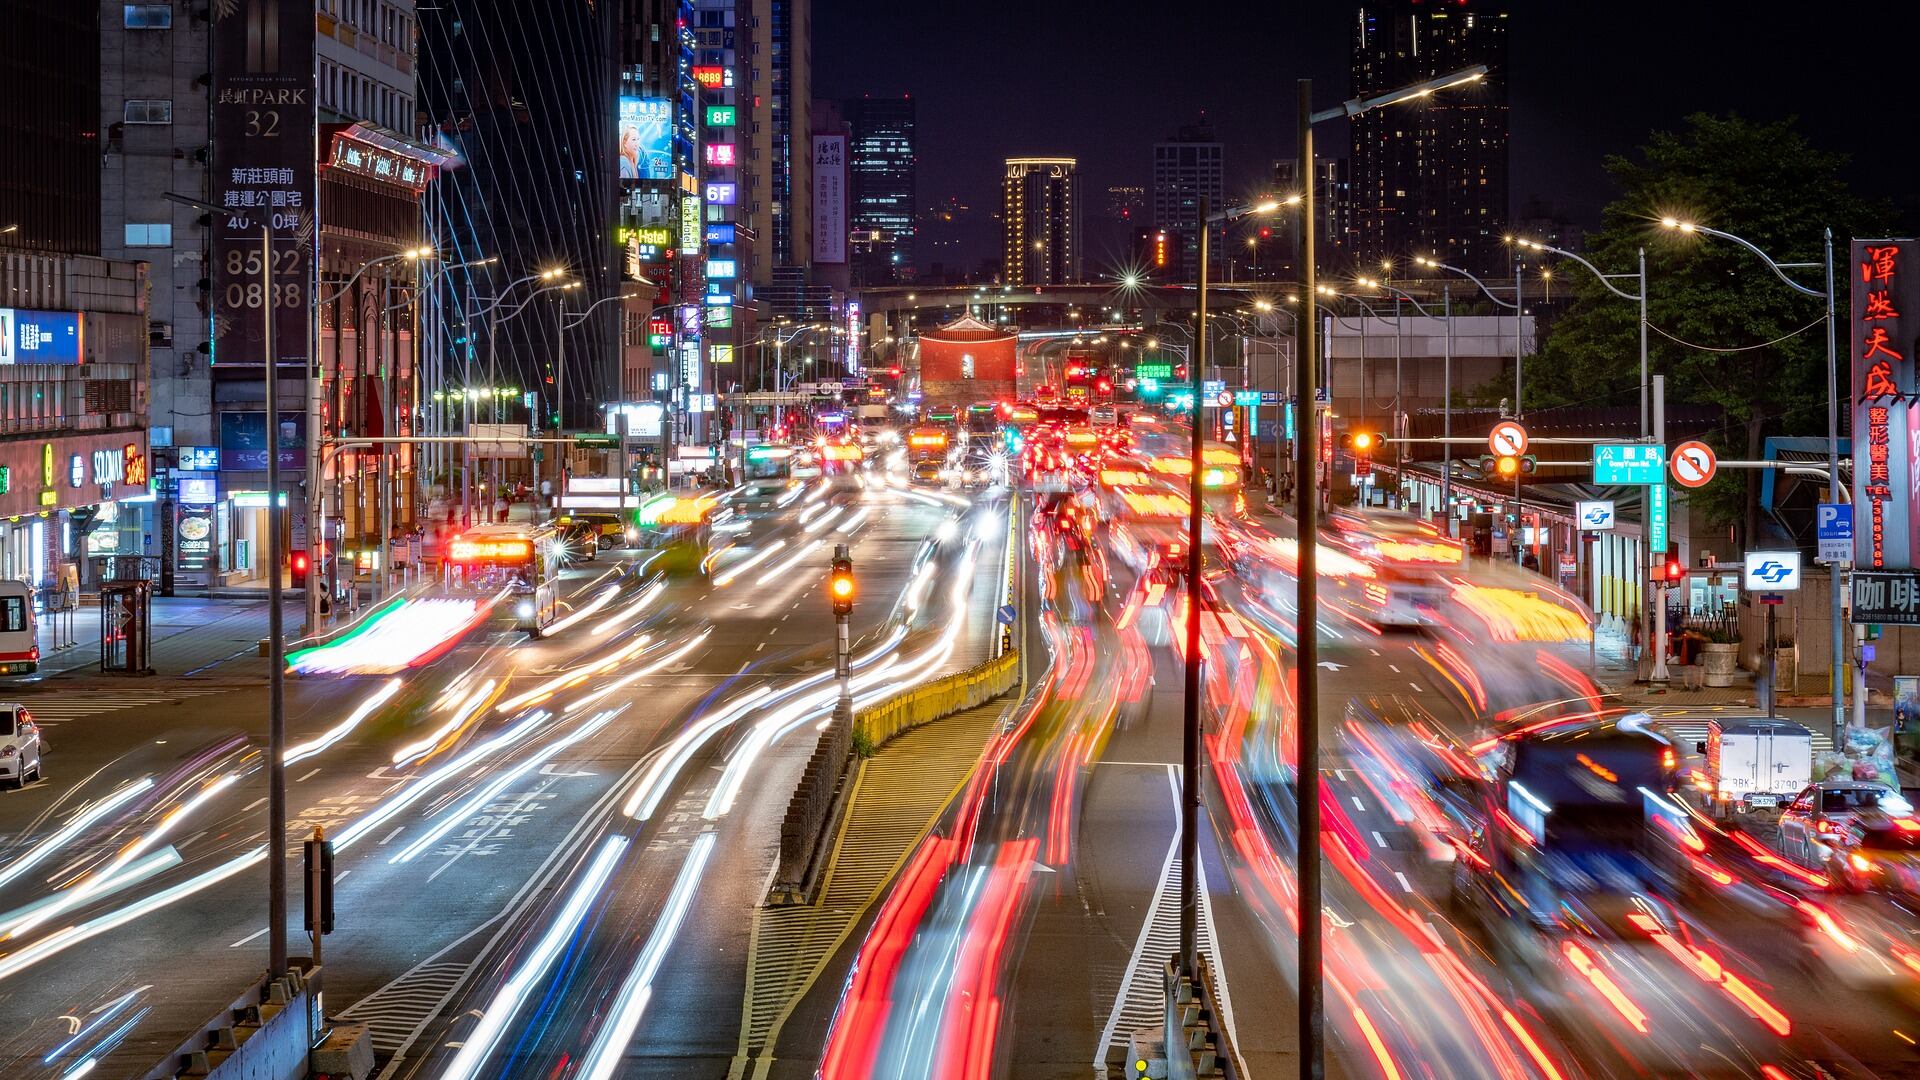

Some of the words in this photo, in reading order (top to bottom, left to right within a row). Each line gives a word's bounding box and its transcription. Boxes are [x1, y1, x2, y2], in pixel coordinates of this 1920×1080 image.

[218, 88, 248, 105] 長虹
[252, 88, 306, 105] PARK
[245, 110, 280, 137] 32
[712, 111, 732, 124] 8F
[232, 168, 294, 184] 新莊頭前
[224, 190, 302, 207] 捷運公園宅
[707, 186, 731, 202] 6F
[638, 229, 667, 244] Hotel
[684, 220, 692, 244] Hotel
[652, 323, 672, 334] TEL
[1601, 447, 1658, 460] 公園路
[1868, 407, 1890, 484] 整形醫美
[94, 450, 123, 485] SOLOMAX
[1866, 486, 1890, 495] TEL
[1820, 507, 1838, 528] P
[1873, 498, 1883, 568] 23883188
[1824, 550, 1847, 560] 停車場
[1856, 577, 1920, 613] 咖啡
[1773, 779, 1798, 790] 3790
